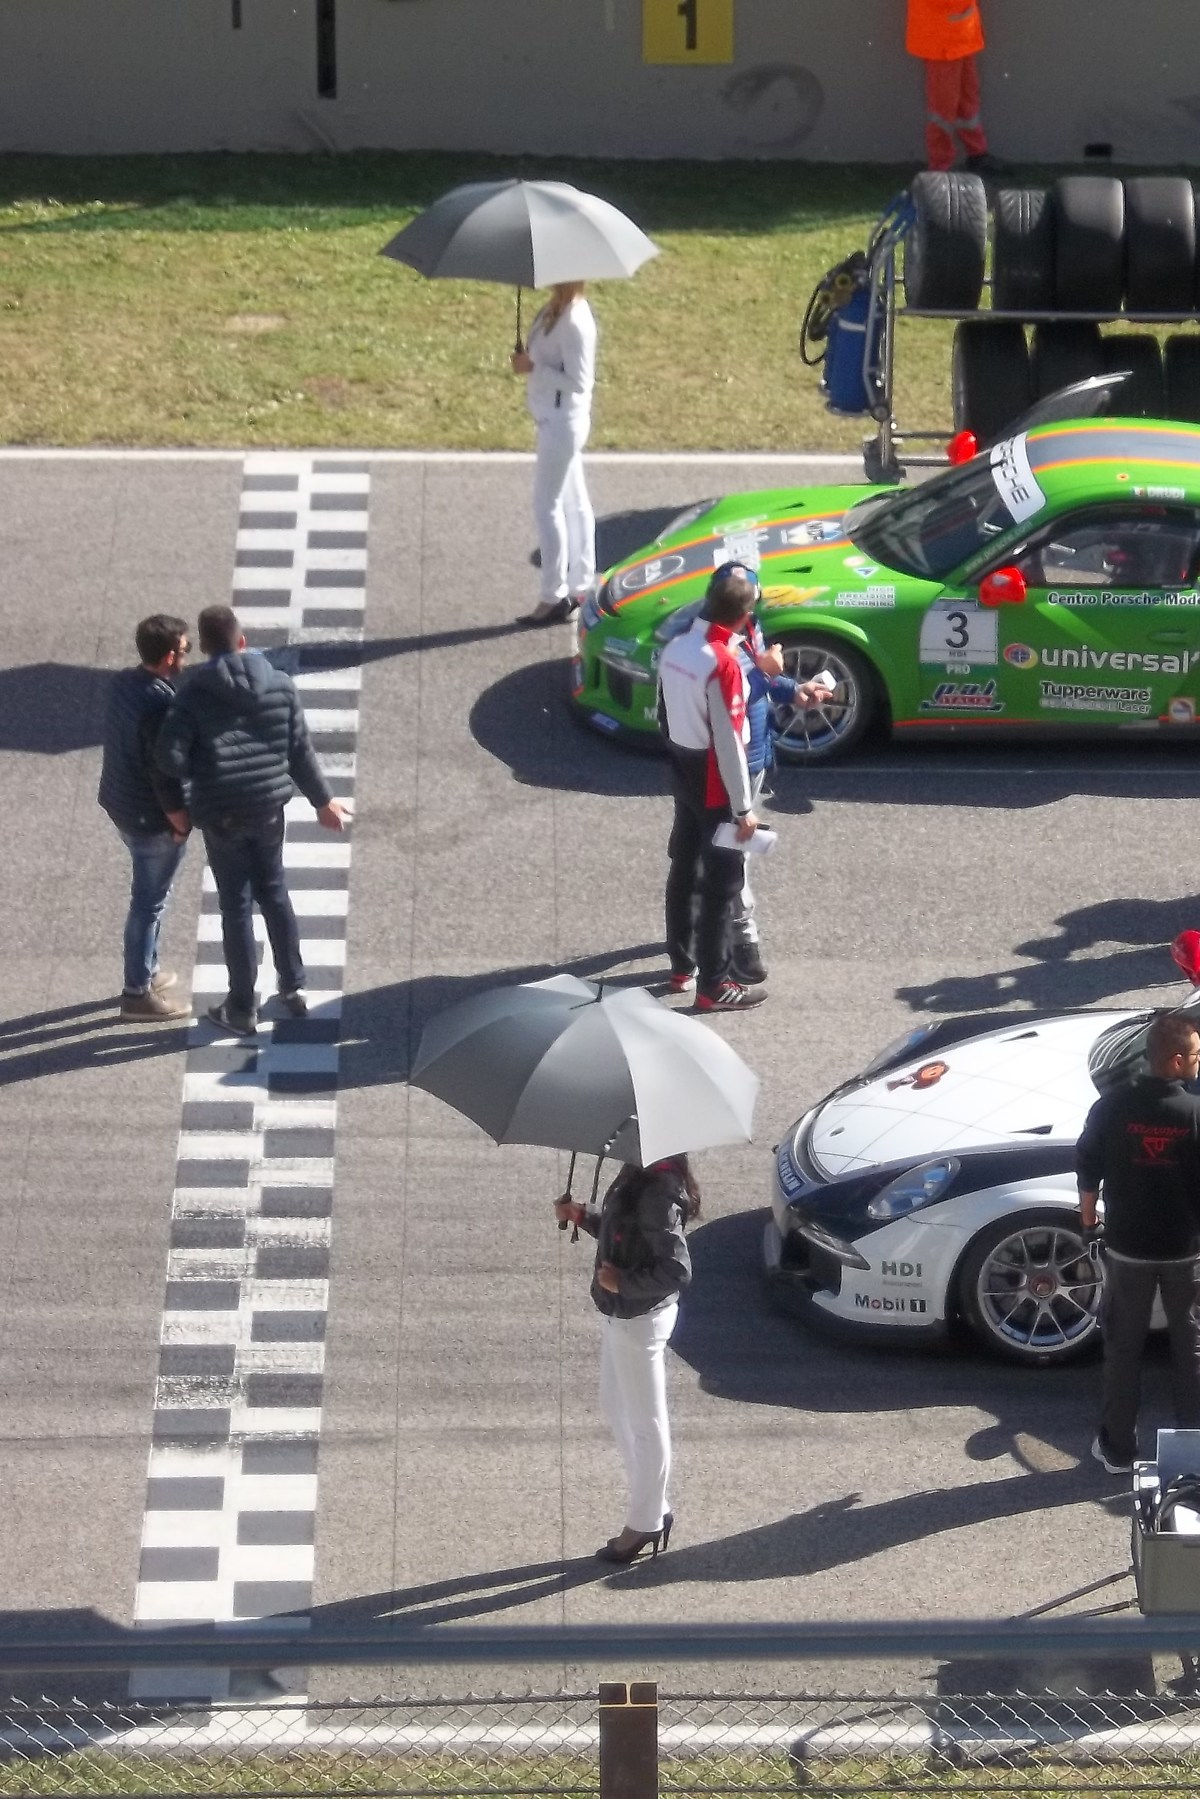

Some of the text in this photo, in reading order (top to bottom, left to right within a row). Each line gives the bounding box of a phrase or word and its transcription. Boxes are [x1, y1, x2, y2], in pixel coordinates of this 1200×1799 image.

[677, 0, 697, 50] 1
[1000, 436, 1031, 505] ORSCHE
[1048, 591, 1097, 605] Centro
[1101, 591, 1162, 605] Porsche
[945, 611, 970, 649] 3
[946, 663, 971, 674] PRO
[1040, 680, 1151, 702] Tupperware
[881, 1260, 922, 1278] HDI
[854, 1293, 905, 1311] Mobil
